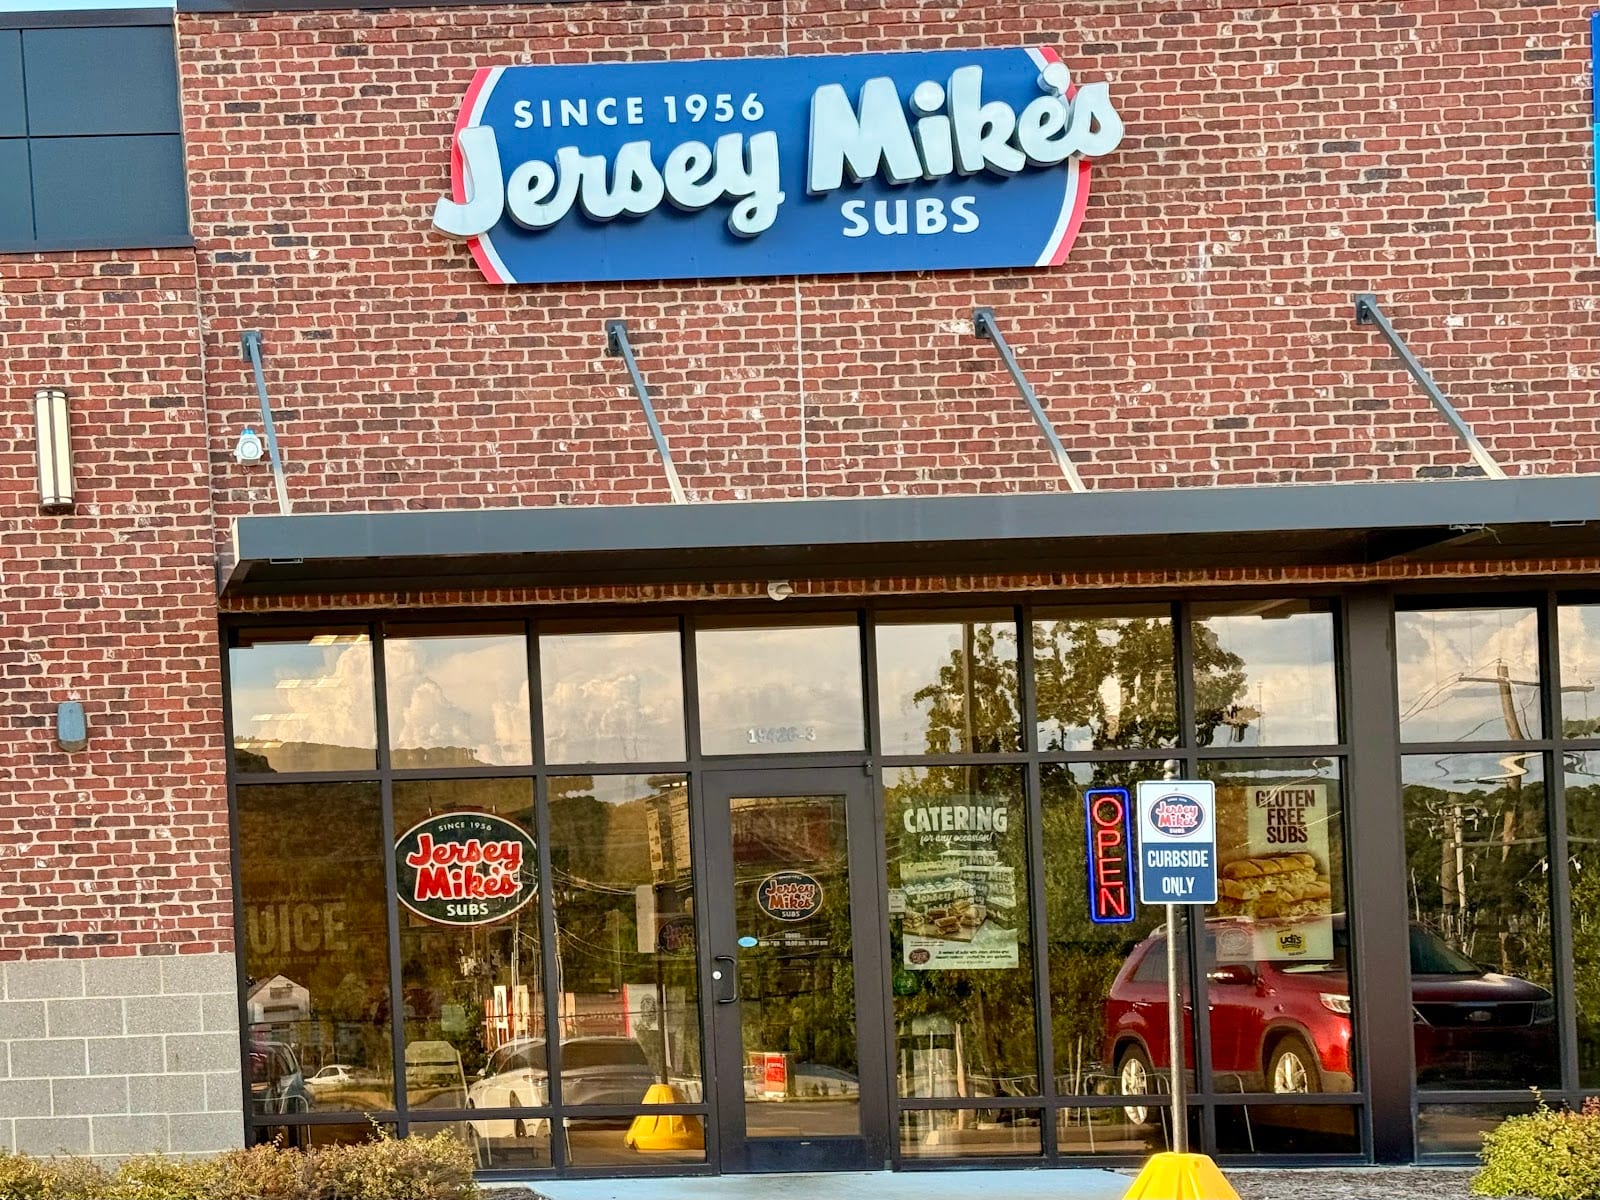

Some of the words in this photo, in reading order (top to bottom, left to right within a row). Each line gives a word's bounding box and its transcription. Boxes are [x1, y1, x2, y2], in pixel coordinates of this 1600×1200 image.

[514, 96, 645, 129] SINCE
[663, 93, 765, 124] 1956
[431, 124, 786, 239] Jersey
[806, 62, 1125, 197] Mike's
[841, 195, 981, 238] SUBS
[1155, 801, 1199, 815] Jersey
[1255, 789, 1316, 808] GLUTEN
[438, 821, 466, 832] SINCE
[470, 821, 493, 832] 1956
[903, 806, 1008, 834] CATERING
[1158, 813, 1198, 827] Mike's
[1267, 808, 1306, 826] FREE
[920, 834, 934, 846] for
[935, 834, 953, 845] any
[1266, 825, 1308, 844] SUBS
[406, 833, 524, 873] Jersey
[1092, 797, 1126, 916] OPEN
[1147, 849, 1209, 868] CURBSIDE
[415, 864, 523, 901] Mike's
[765, 880, 816, 900] Jersey
[1162, 876, 1195, 897] ONLY
[446, 903, 489, 916] SUBS
[768, 894, 816, 911] Mike's
[248, 902, 349, 953] UICE
[1279, 933, 1303, 945] udi's
